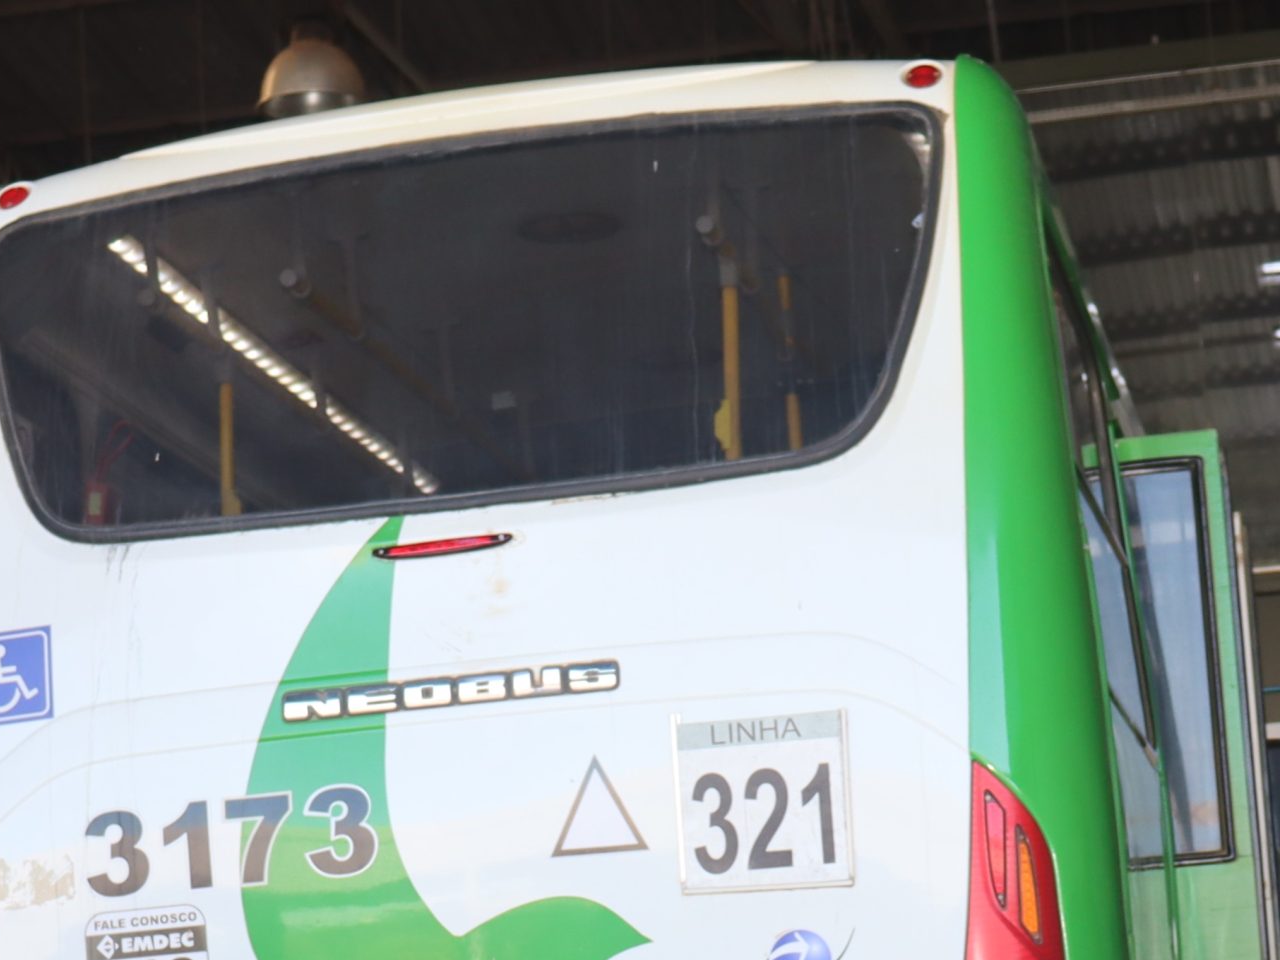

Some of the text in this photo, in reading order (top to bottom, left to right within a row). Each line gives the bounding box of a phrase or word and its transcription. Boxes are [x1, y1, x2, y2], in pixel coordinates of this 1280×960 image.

[282, 659, 621, 723] NEOBUS
[710, 718, 801, 746] LINHA
[84, 783, 380, 897] 3173
[692, 763, 836, 875] 321
[94, 911, 197, 931] FALE CONOSCO
[121, 930, 195, 953] EMDEC
